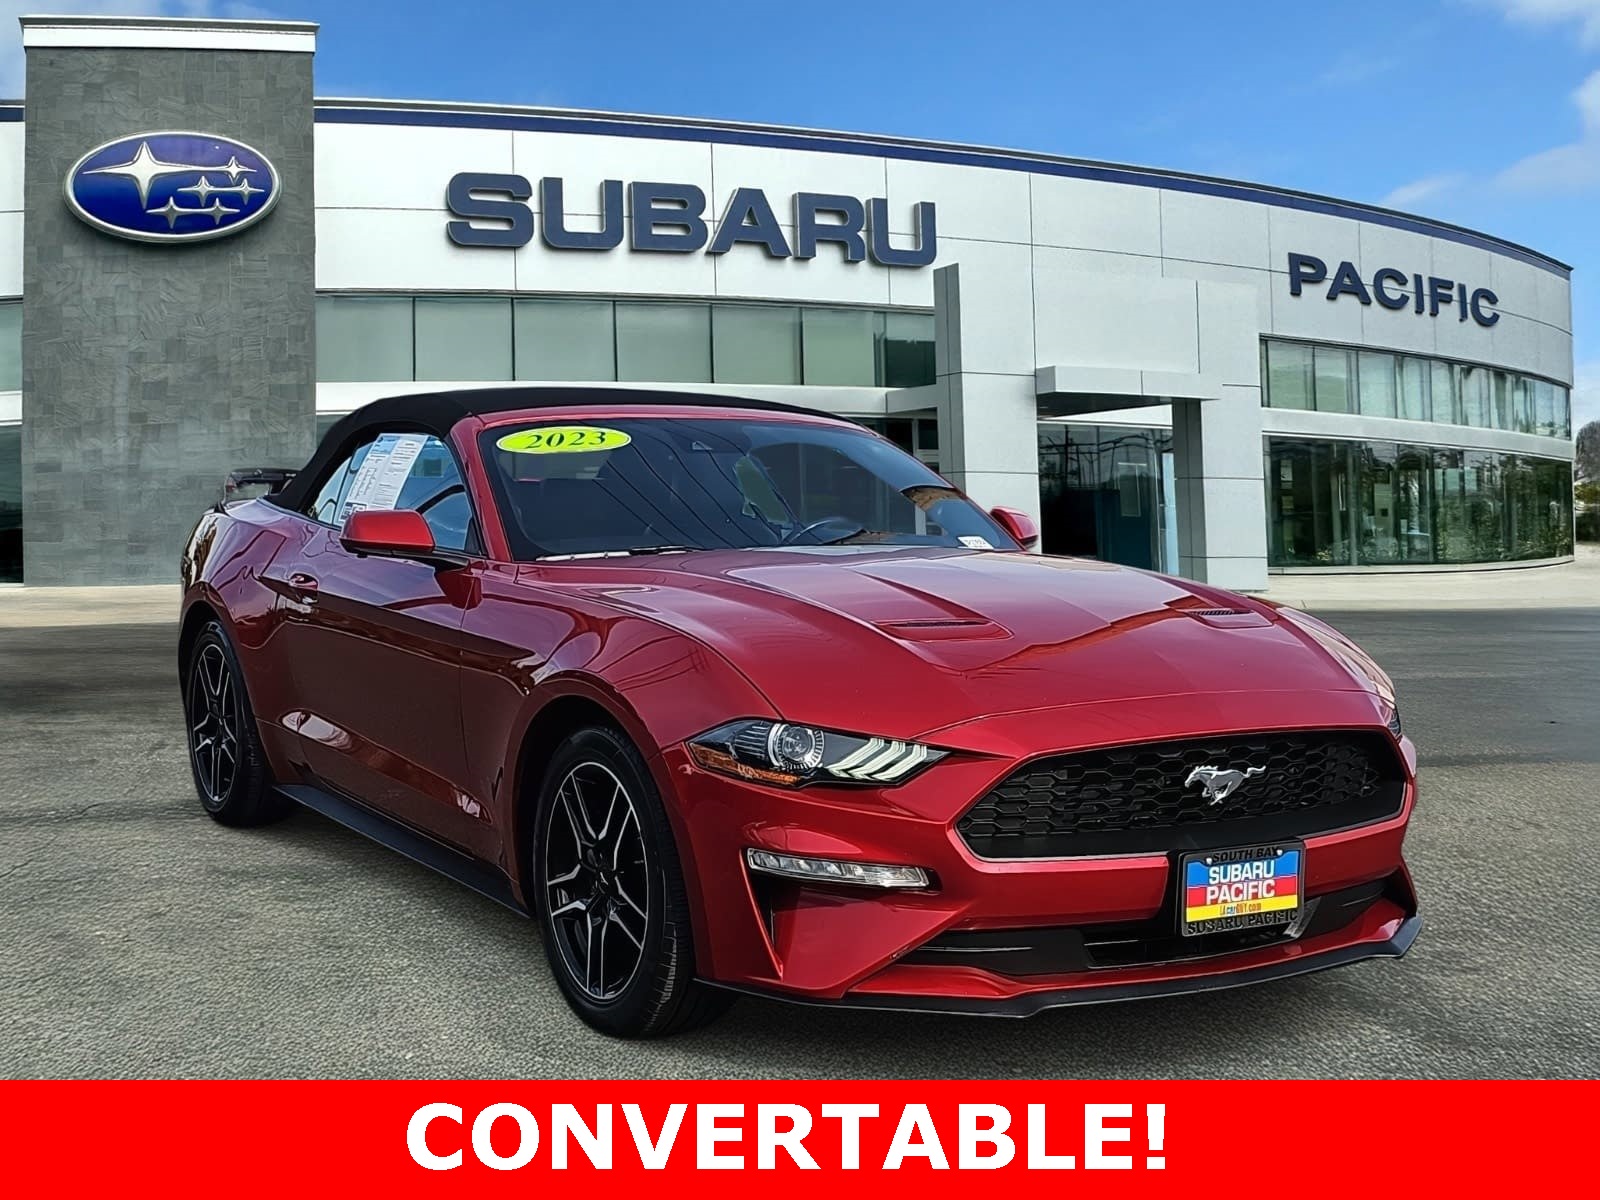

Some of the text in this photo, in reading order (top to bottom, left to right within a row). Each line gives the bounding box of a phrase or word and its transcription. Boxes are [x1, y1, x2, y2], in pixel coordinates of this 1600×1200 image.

[446, 171, 937, 267] SUBARU
[1287, 251, 1500, 327] PACIFIC
[525, 431, 606, 449] 2023
[1212, 846, 1279, 863] SOUTH BAY
[1208, 860, 1275, 885] SUBARU
[1206, 879, 1275, 905] PACIFIC
[1248, 910, 1298, 926] PACIFIC
